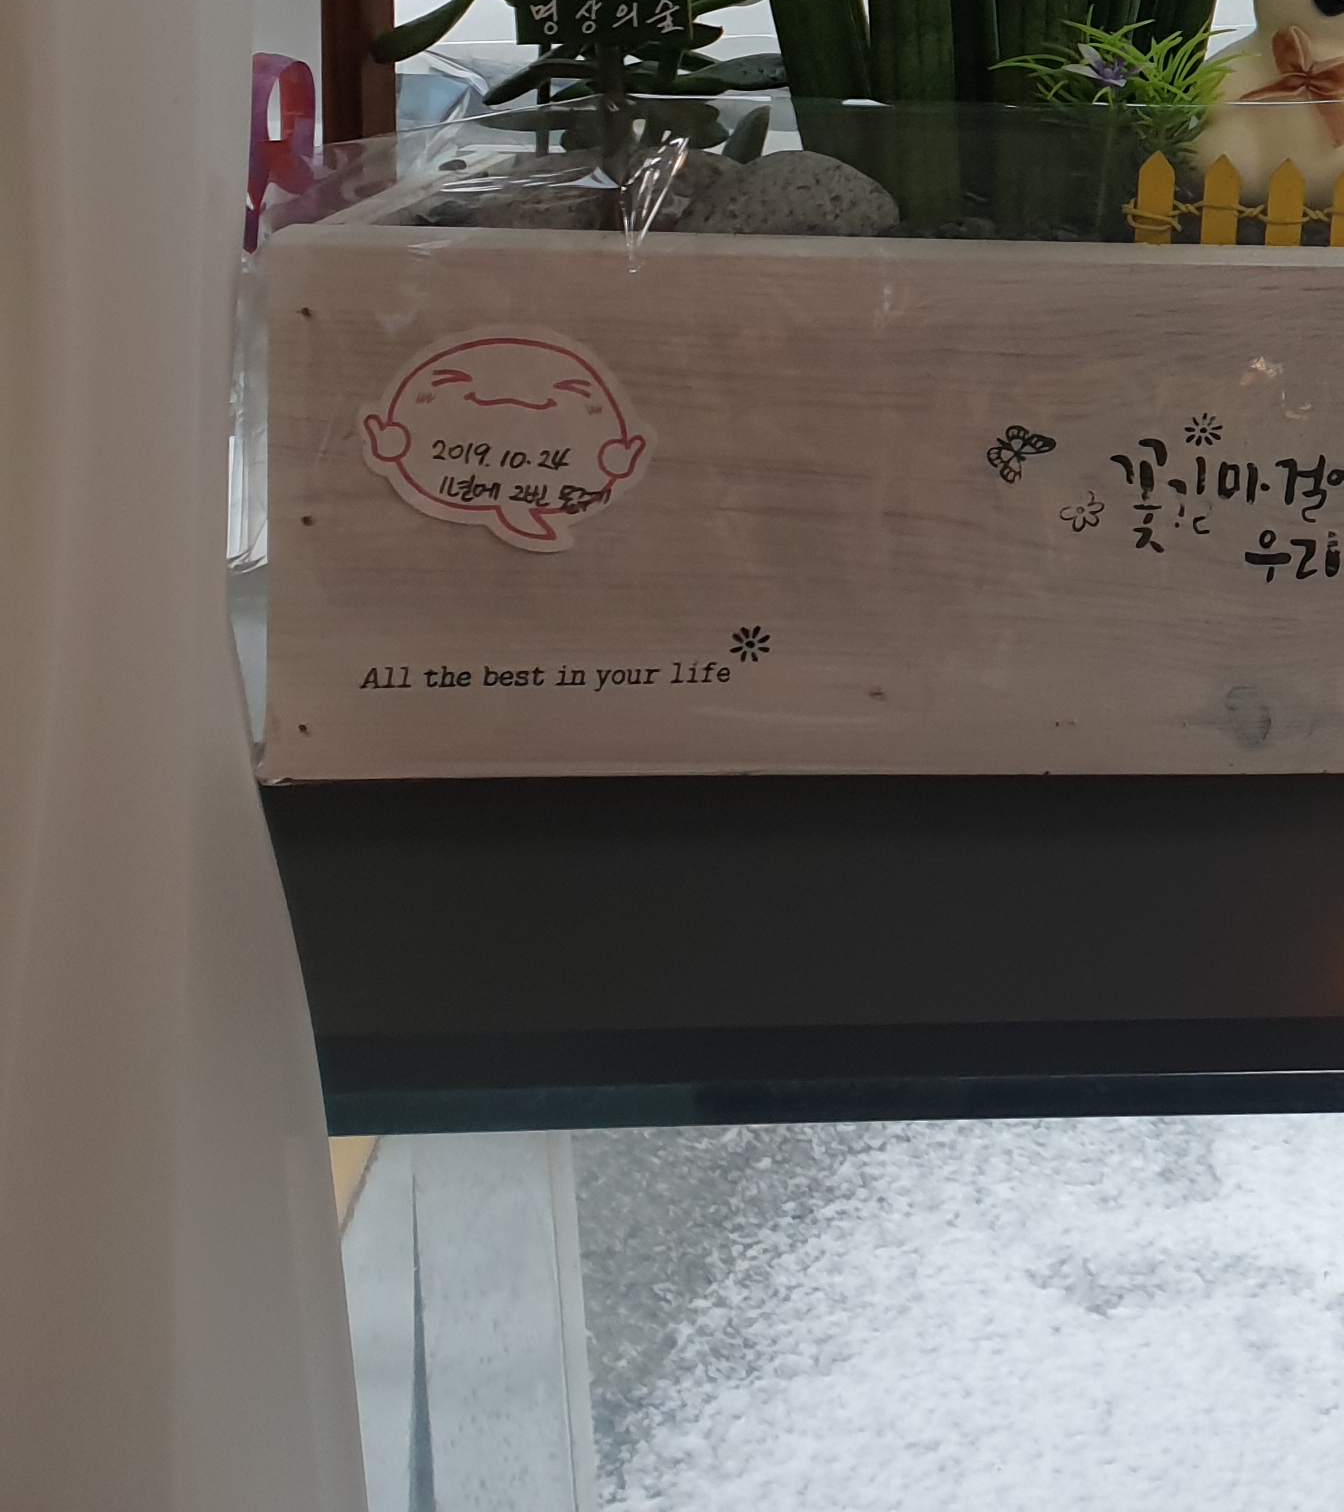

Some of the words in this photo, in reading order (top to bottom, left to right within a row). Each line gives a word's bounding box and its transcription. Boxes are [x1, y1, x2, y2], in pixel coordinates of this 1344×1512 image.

[1243, 528, 1342, 584] 우리
[358, 665, 413, 690] All
[423, 665, 473, 688] the
[482, 664, 546, 688] best
[556, 663, 587, 686] in
[593, 665, 661, 693] your
[669, 661, 732, 685] life
